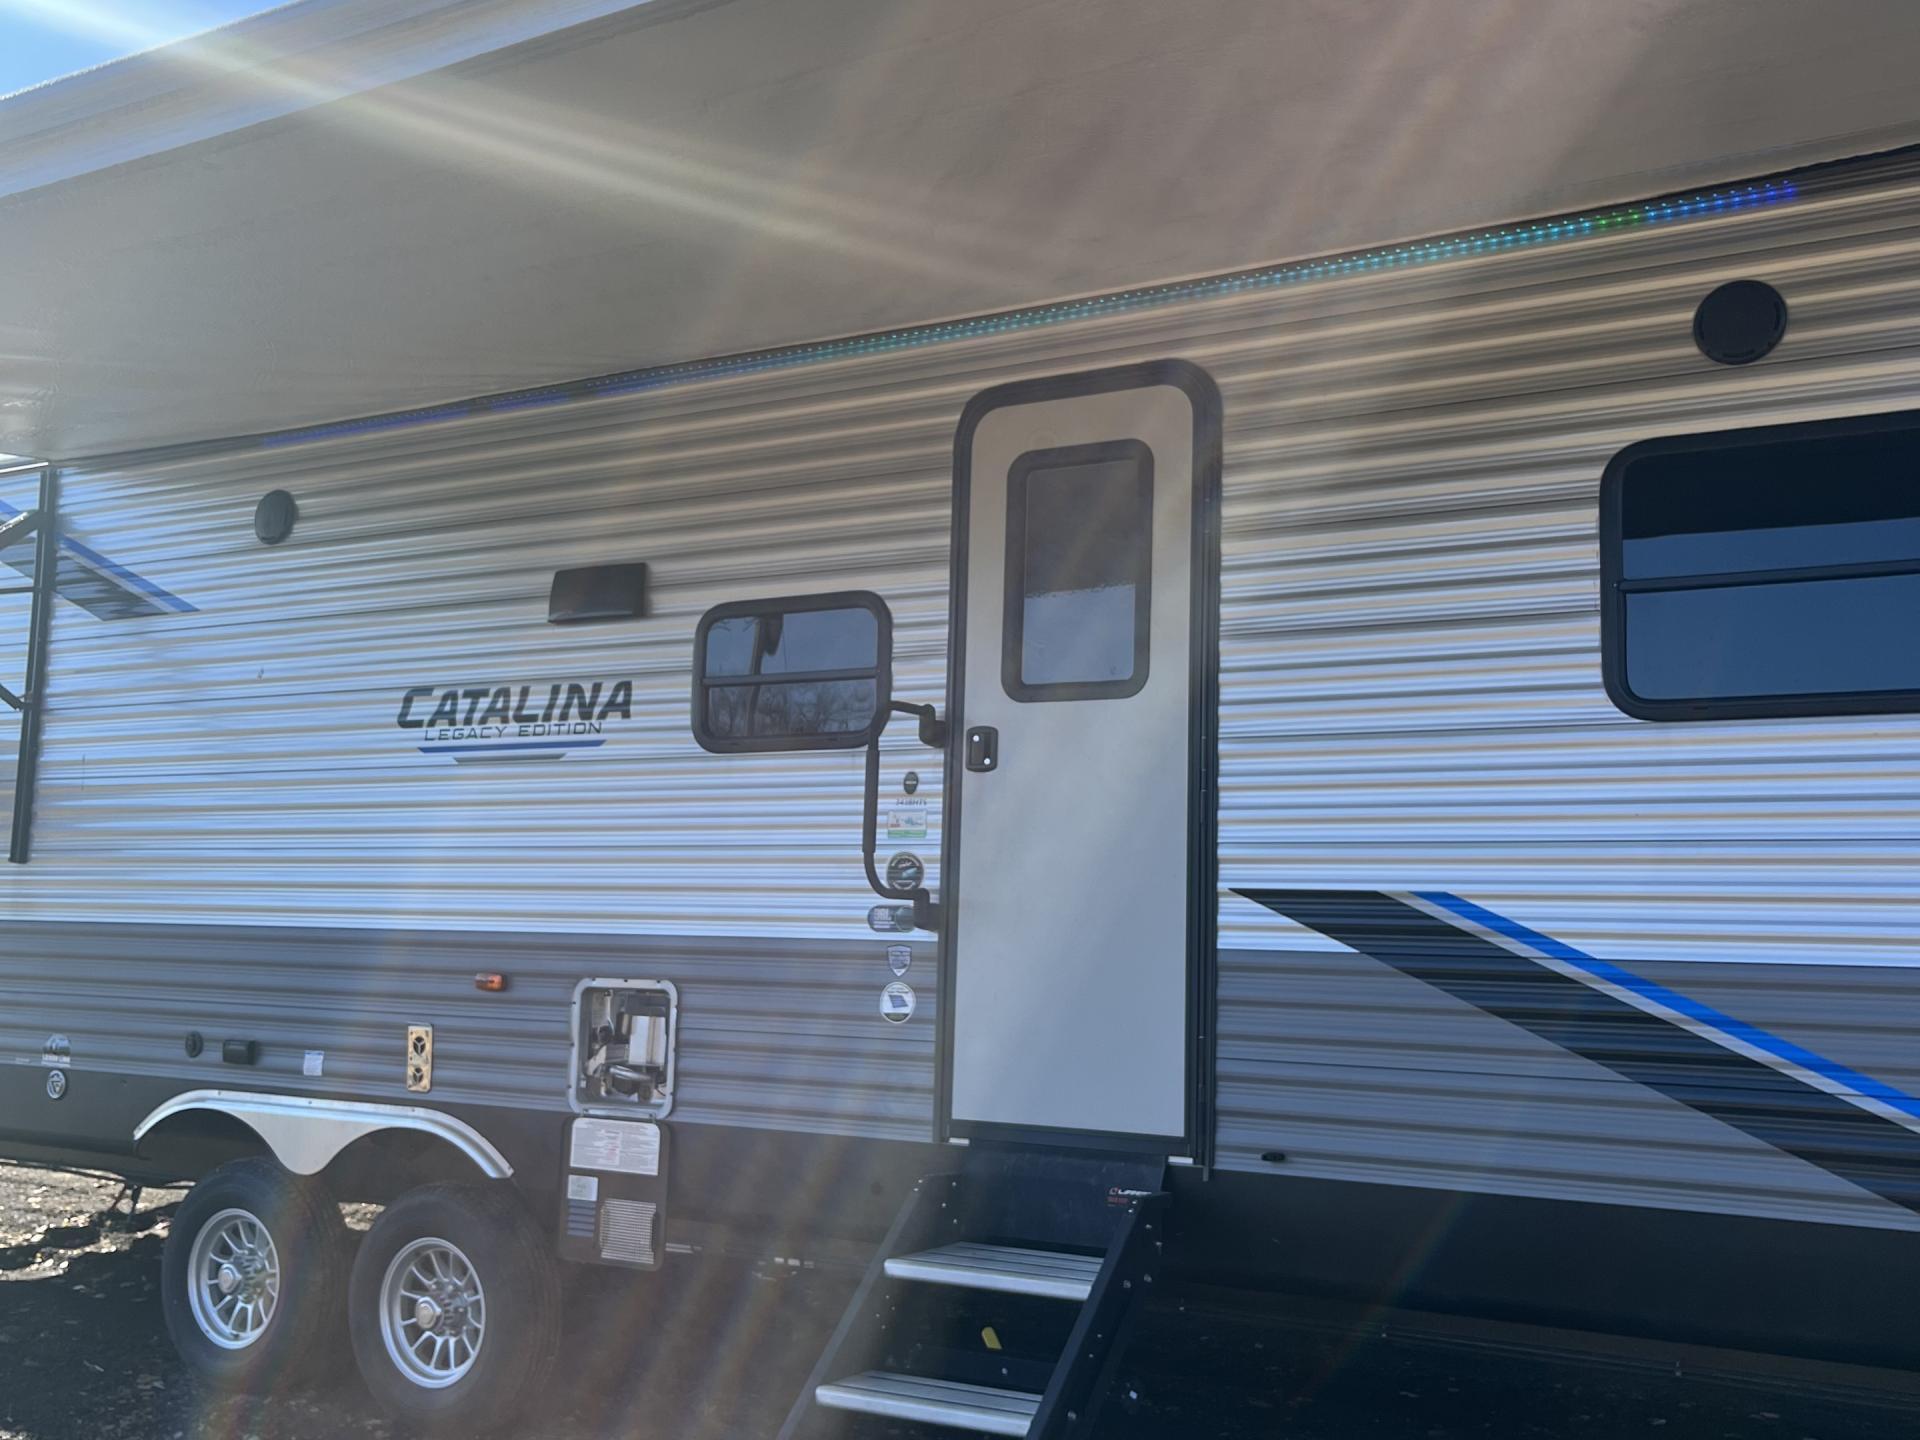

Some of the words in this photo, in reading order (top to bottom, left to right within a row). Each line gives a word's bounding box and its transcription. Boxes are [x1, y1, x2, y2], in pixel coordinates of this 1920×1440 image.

[397, 681, 632, 728] CATALINA
[424, 726, 508, 741] LEGACY
[518, 722, 603, 737] EDITION
